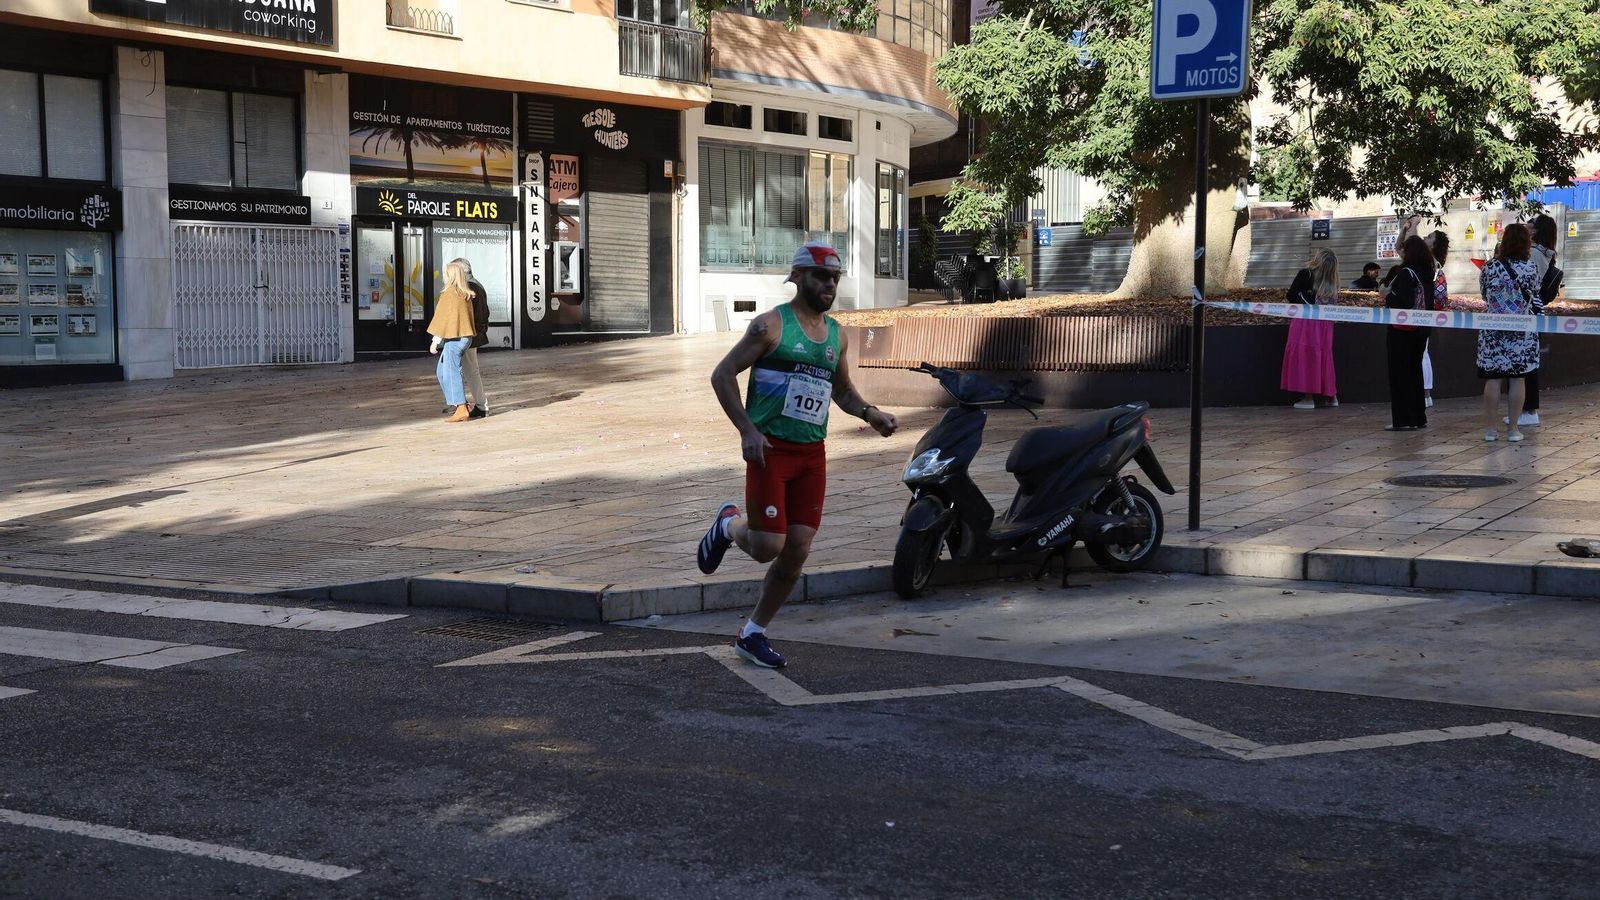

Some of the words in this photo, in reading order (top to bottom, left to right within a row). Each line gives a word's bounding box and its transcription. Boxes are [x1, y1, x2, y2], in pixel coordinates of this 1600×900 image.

[243, 9, 316, 34] coworking
[1158, 0, 1217, 86] P
[1185, 66, 1238, 87] MOTOS
[353, 111, 389, 123] GESTIÓN
[390, 115, 401, 124] DE
[406, 116, 463, 130] APARTAMENTOS
[466, 122, 511, 135] TURÍSTICOS
[595, 108, 616, 129] SOLE
[594, 129, 629, 150] HUNTERS
[549, 160, 577, 175] ATM
[407, 192, 418, 200] DEL
[170, 199, 237, 212] GESTIONAMOS
[240, 204, 253, 213] SU
[255, 204, 308, 216] PATRIMONIO
[407, 200, 451, 216] PARQUE
[456, 200, 498, 219] FLATS
[432, 226, 456, 234] HOLIDAY
[530, 168, 540, 304] SNEAKERS
[794, 363, 832, 380] ATLETISMO
[794, 394, 823, 413] 107
[1046, 514, 1075, 540] YAMAHA
